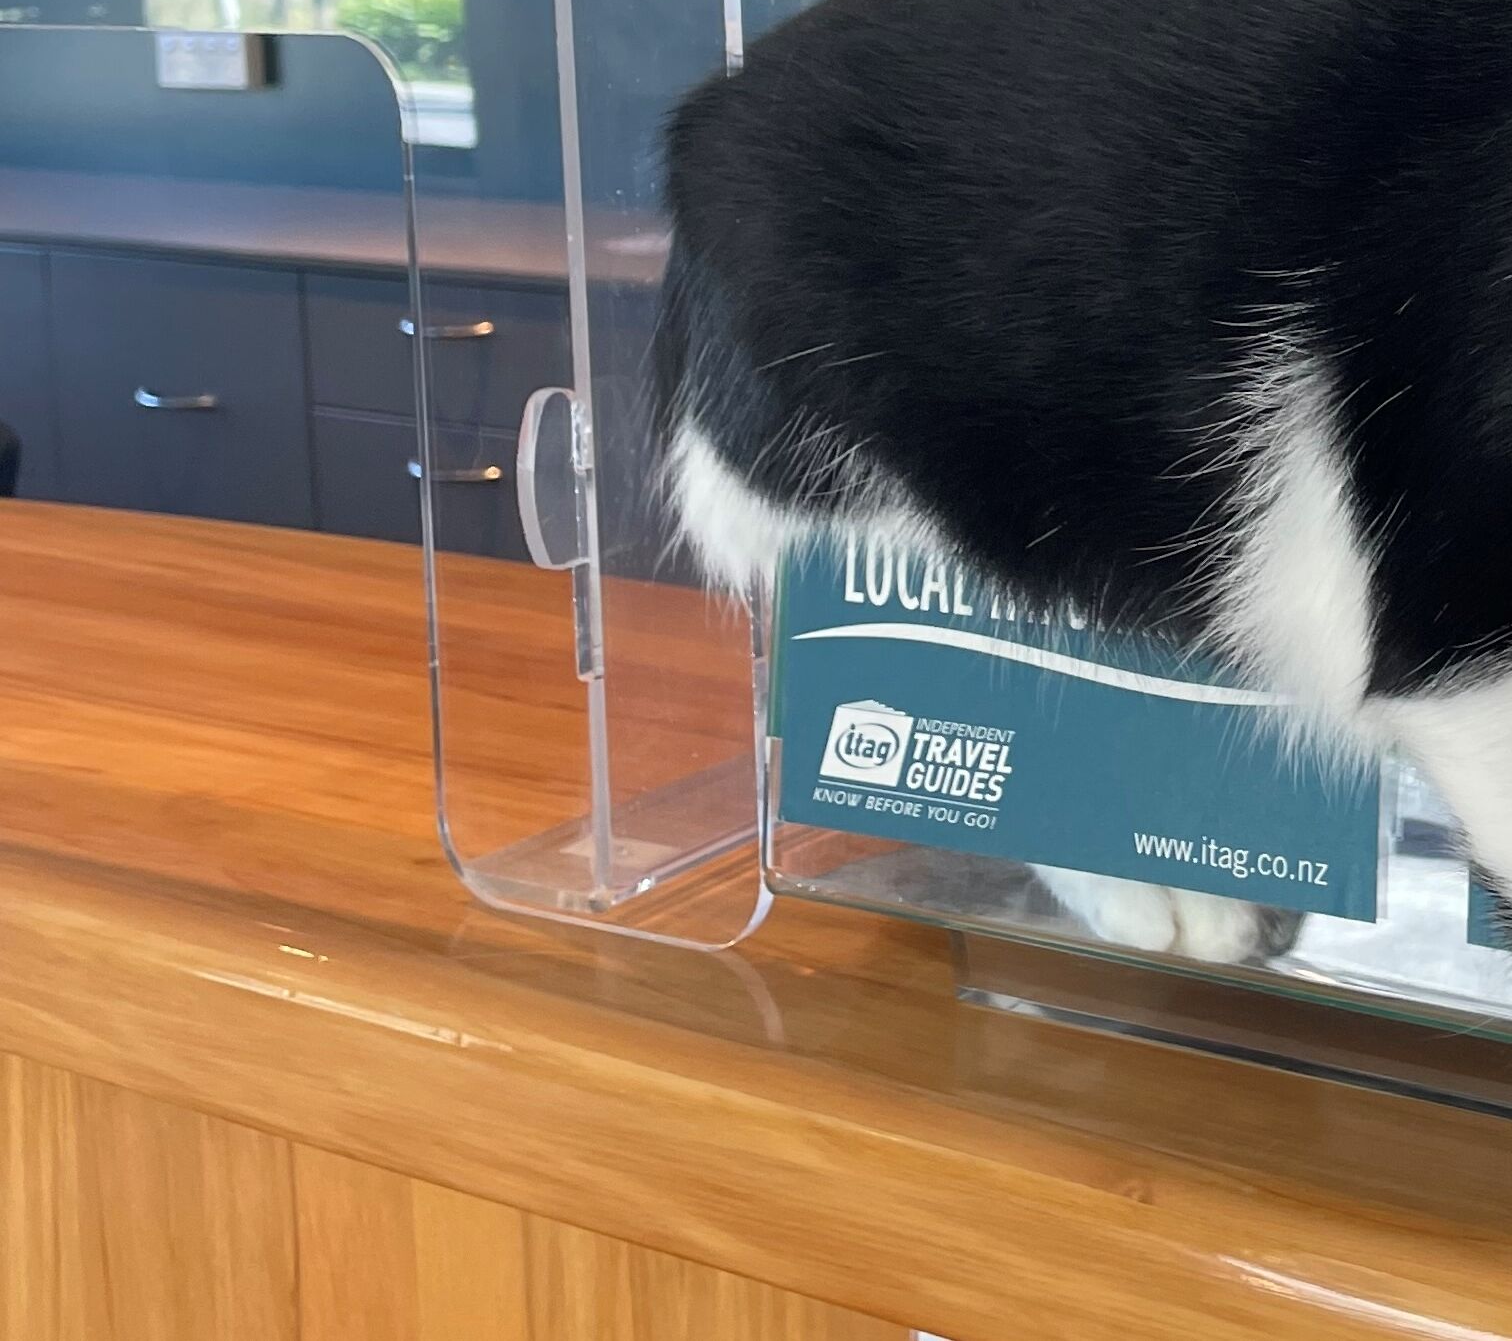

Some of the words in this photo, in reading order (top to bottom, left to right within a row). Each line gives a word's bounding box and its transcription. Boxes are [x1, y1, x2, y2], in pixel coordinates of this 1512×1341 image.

[844, 531, 974, 617] LOCAL
[843, 723, 892, 767] itag
[916, 717, 1016, 744] INDEPENDENT
[913, 732, 1013, 775] TRAVEL
[906, 762, 1006, 802] GUIDES
[812, 787, 864, 807] KNOW
[865, 795, 924, 818] BEFORE
[926, 805, 962, 825] YOU
[963, 812, 998, 830] GO!
[1132, 831, 1330, 887] www.itag.co.nz
